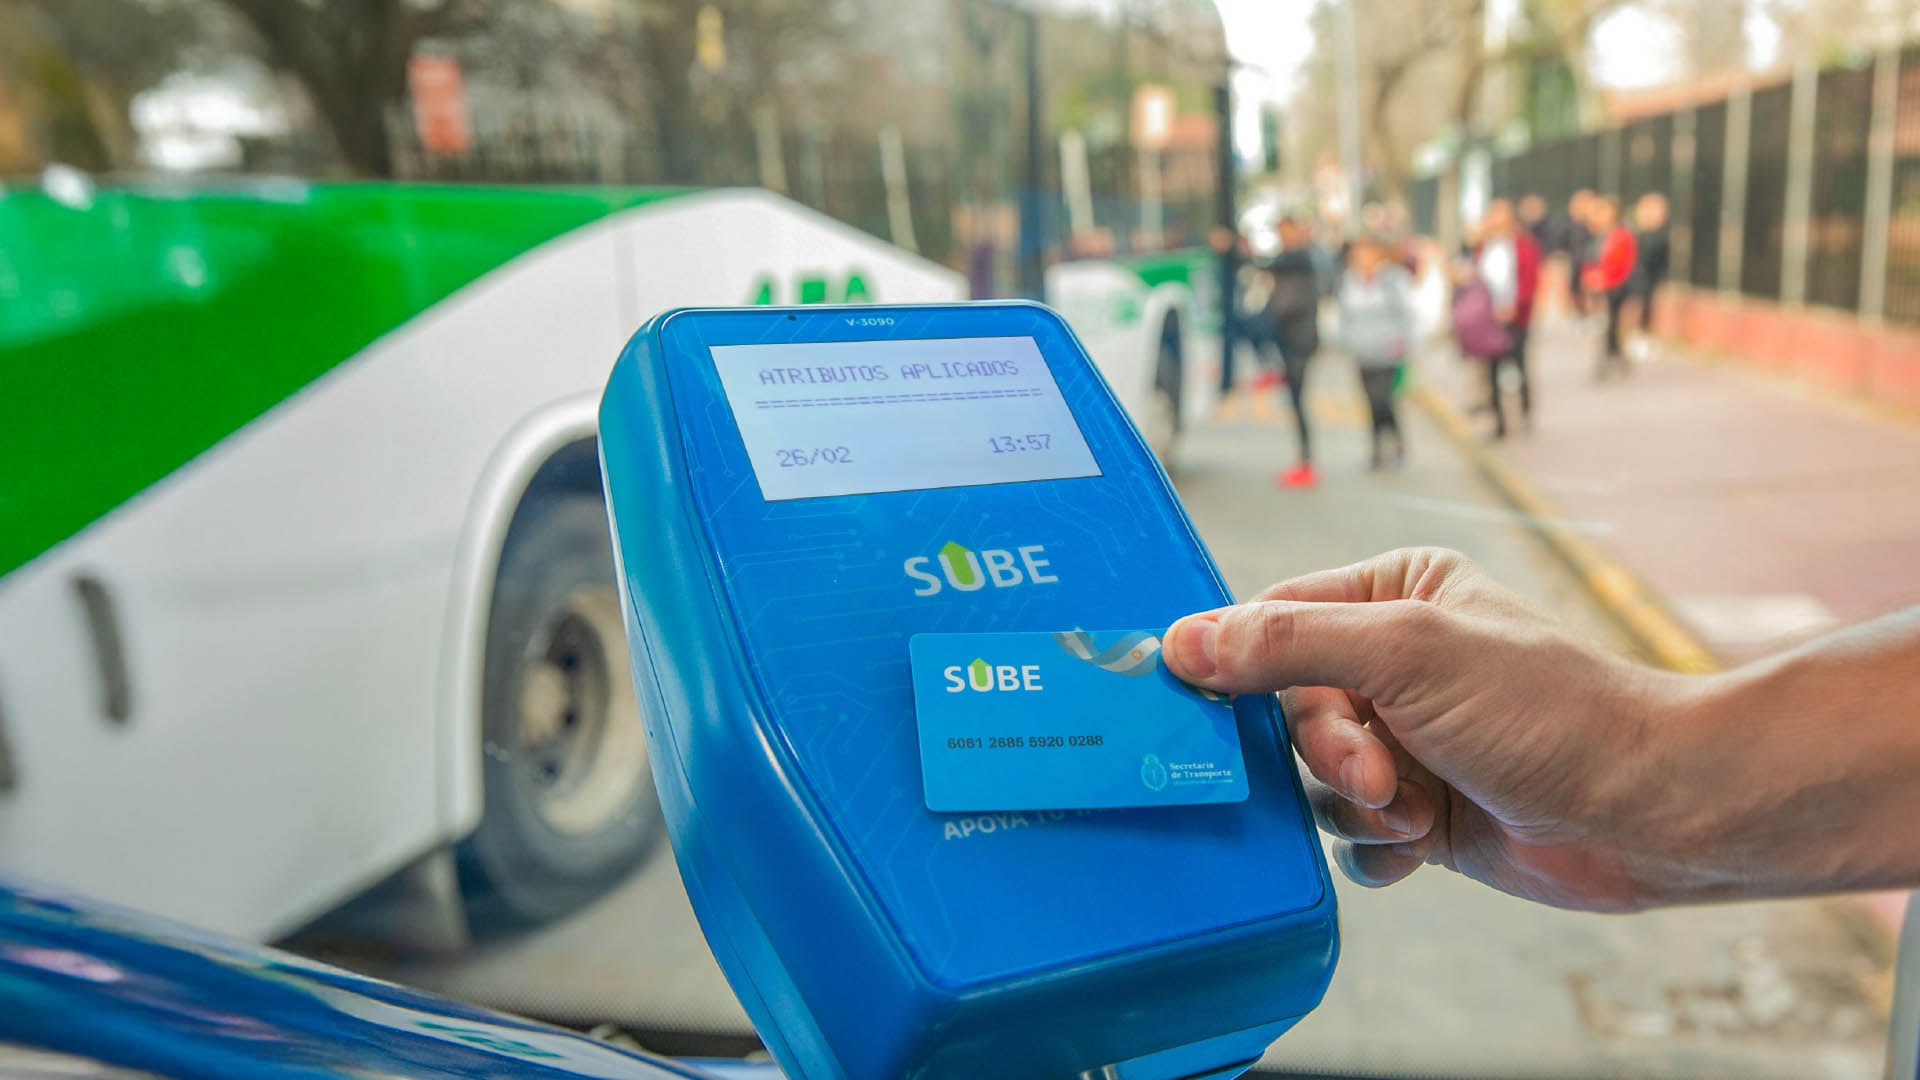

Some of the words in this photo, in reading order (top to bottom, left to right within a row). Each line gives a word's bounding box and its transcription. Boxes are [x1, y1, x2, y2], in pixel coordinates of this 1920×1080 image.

[845, 317, 895, 327] V-3090
[759, 365, 889, 385] ATRIBUTOS
[900, 360, 1019, 379] APLICADOS
[775, 446, 853, 468] 26/02
[989, 434, 1051, 454] 13:57
[904, 541, 1058, 597] SUBE
[943, 658, 1043, 693] SUBE
[989, 736, 1025, 749] 2685
[1028, 736, 1064, 748] 5920
[1068, 735, 1104, 747] 0288
[1171, 771, 1182, 779] de
[1184, 769, 1233, 780] Transporte
[943, 813, 1029, 841] APOYA
